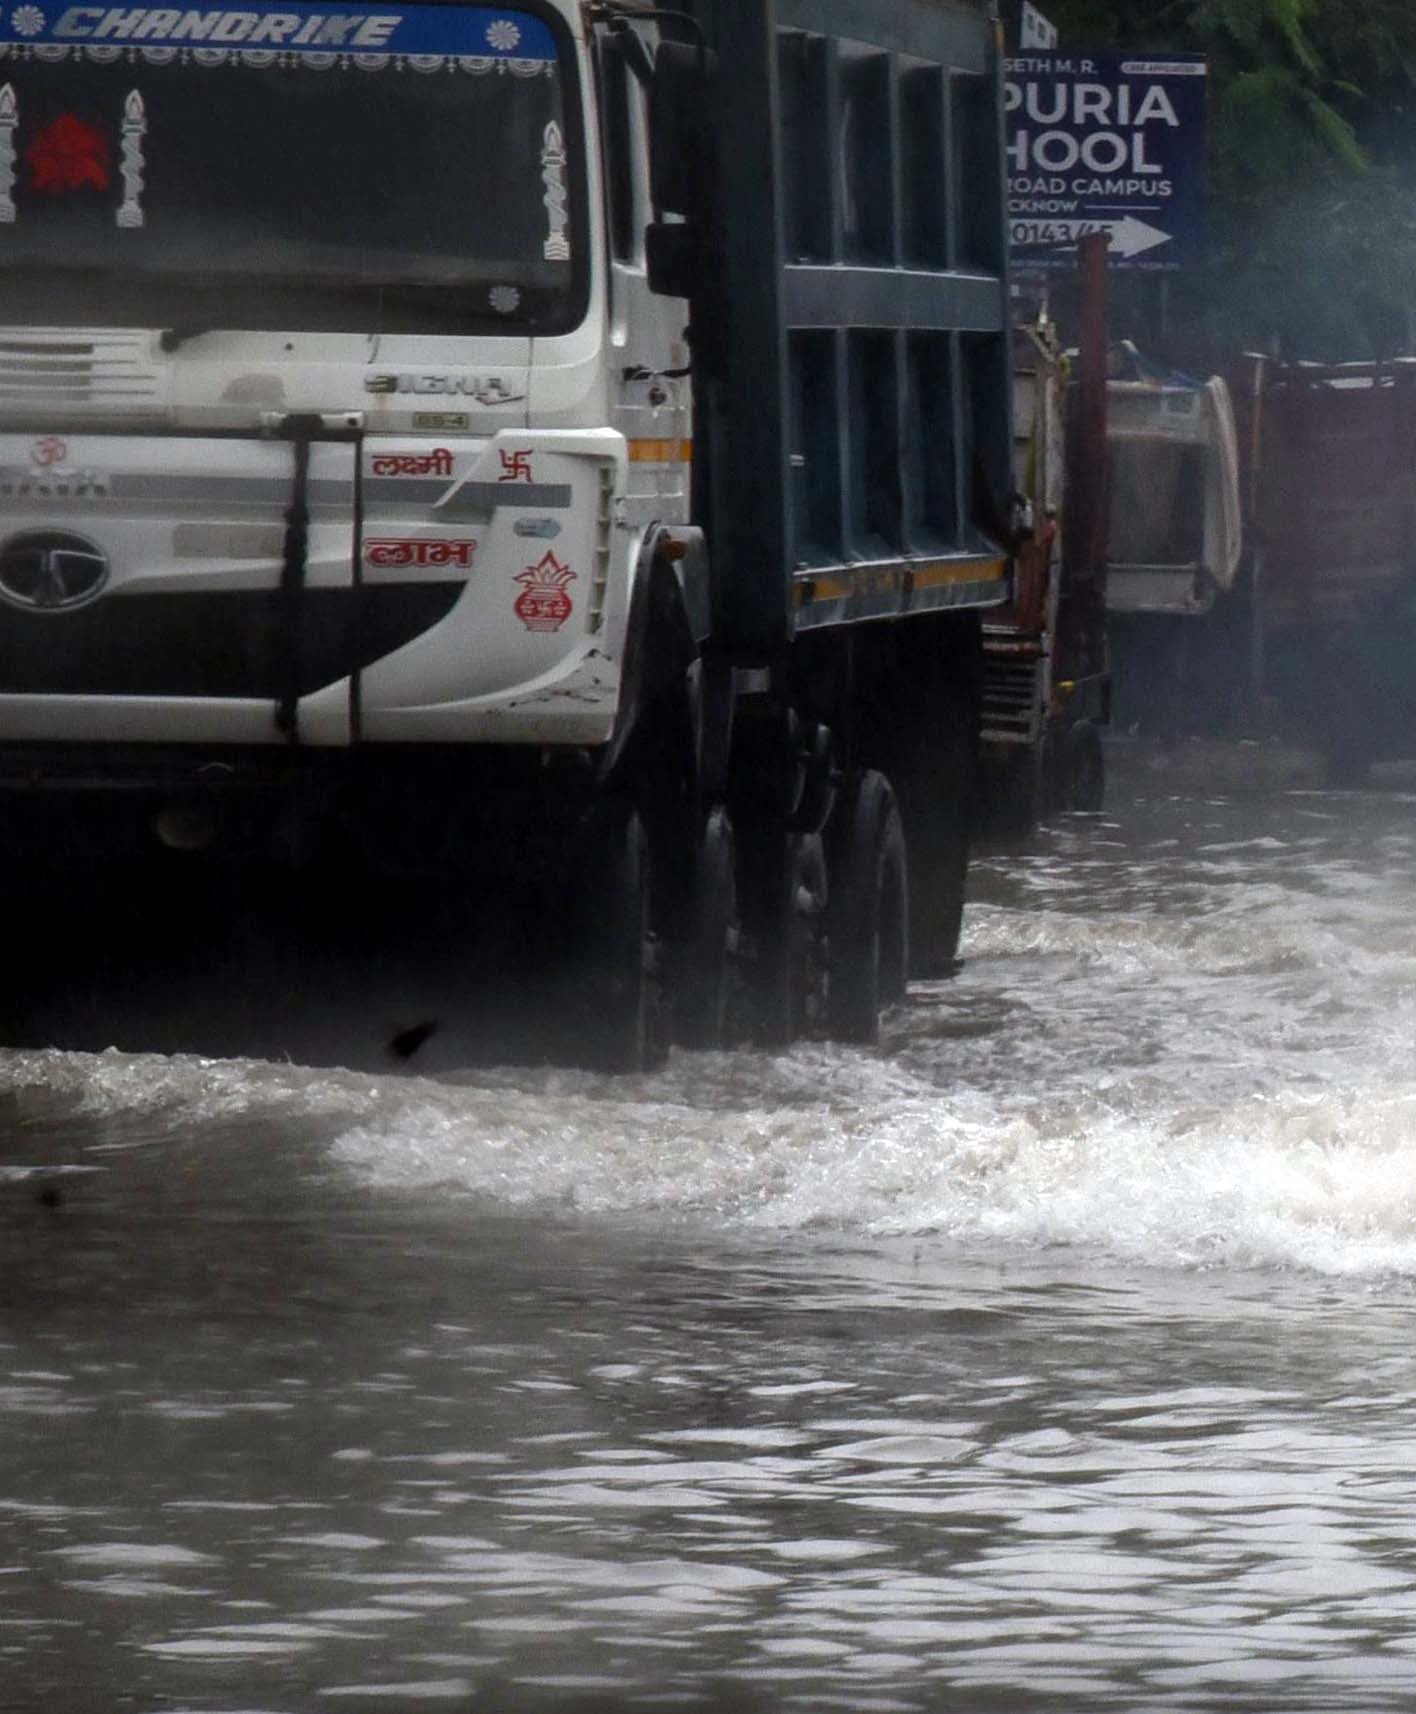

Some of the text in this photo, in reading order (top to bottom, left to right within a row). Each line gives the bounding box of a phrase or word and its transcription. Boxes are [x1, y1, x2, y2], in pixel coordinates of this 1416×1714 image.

[53, 7, 402, 47] CHANDRIKE
[1003, 58, 1098, 74] SETH M. R.
[1072, 179, 1173, 197] CAMPUS
[371, 448, 454, 477] लक्ष्मी
[363, 537, 478, 568] लाभ
